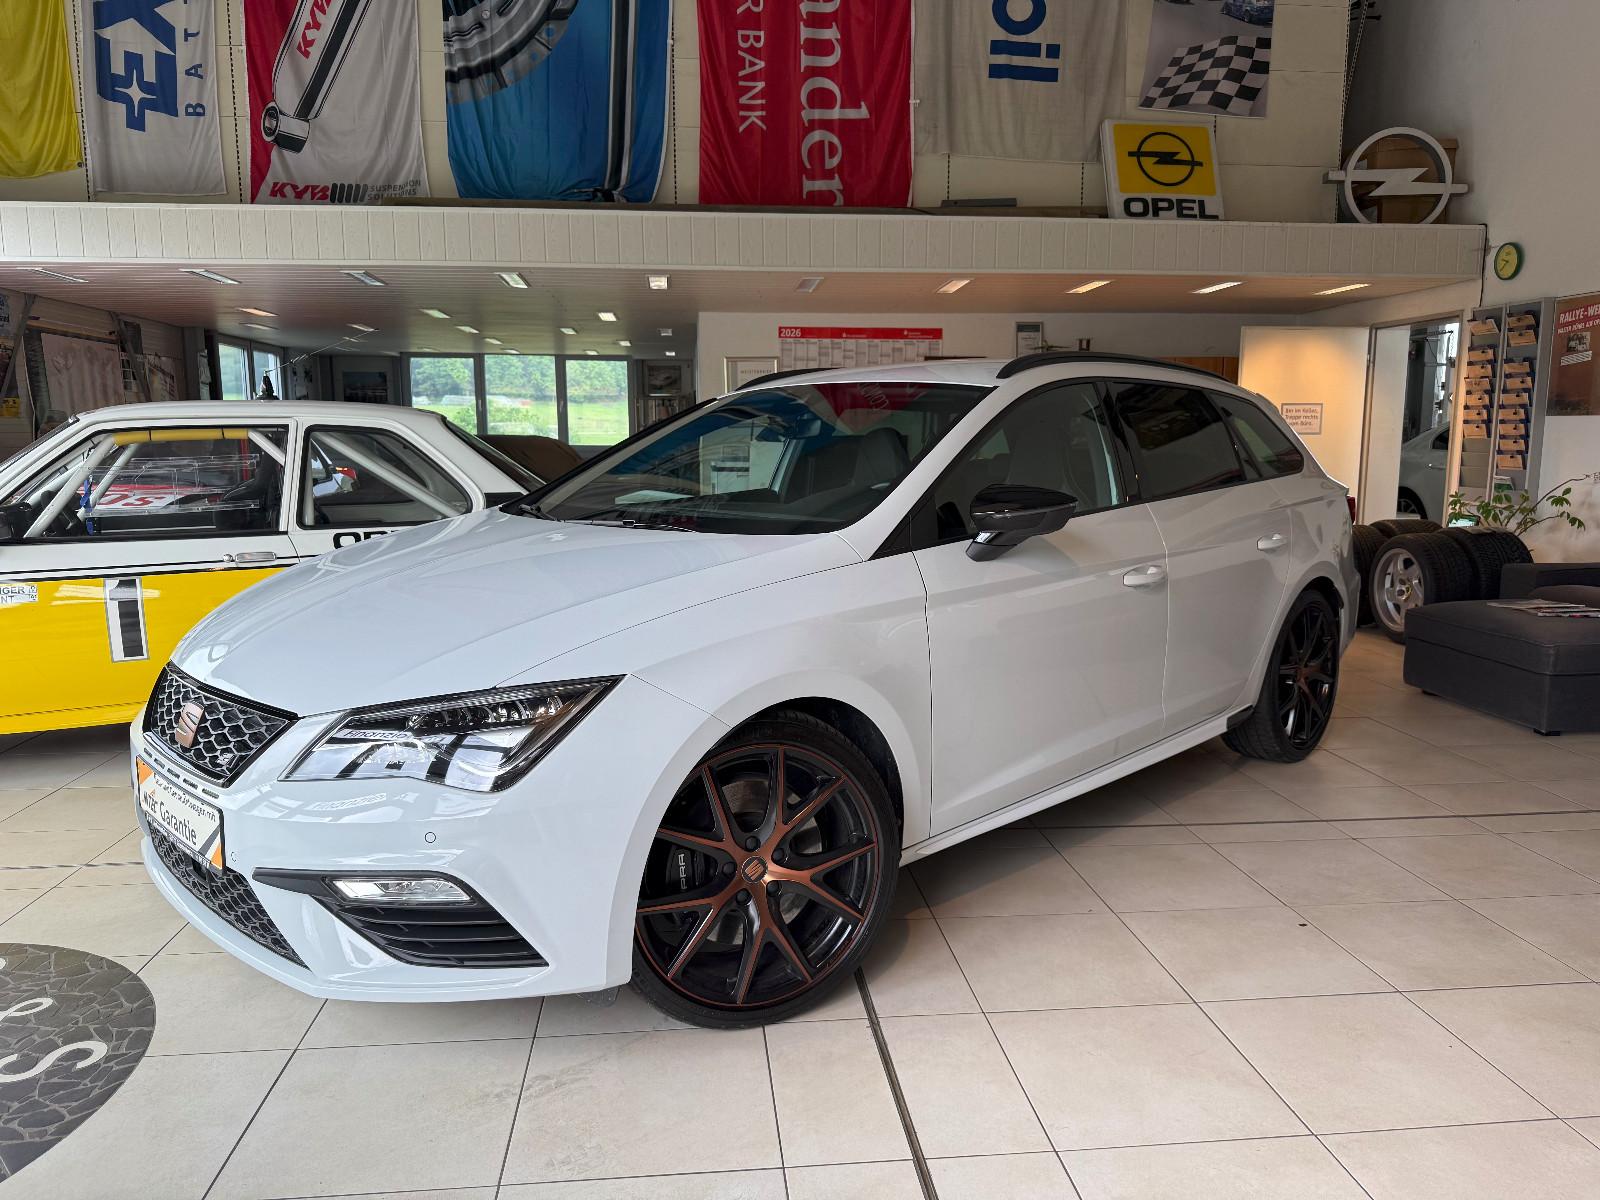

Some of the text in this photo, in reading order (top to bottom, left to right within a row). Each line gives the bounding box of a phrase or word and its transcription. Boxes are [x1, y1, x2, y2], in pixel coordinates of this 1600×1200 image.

[737, 30, 767, 133] BANK
[269, 182, 330, 201] KYB
[1123, 197, 1219, 219] OPEL
[780, 328, 801, 338] 2026
[0, 586, 25, 596] GER
[160, 800, 197, 846] Garantie
